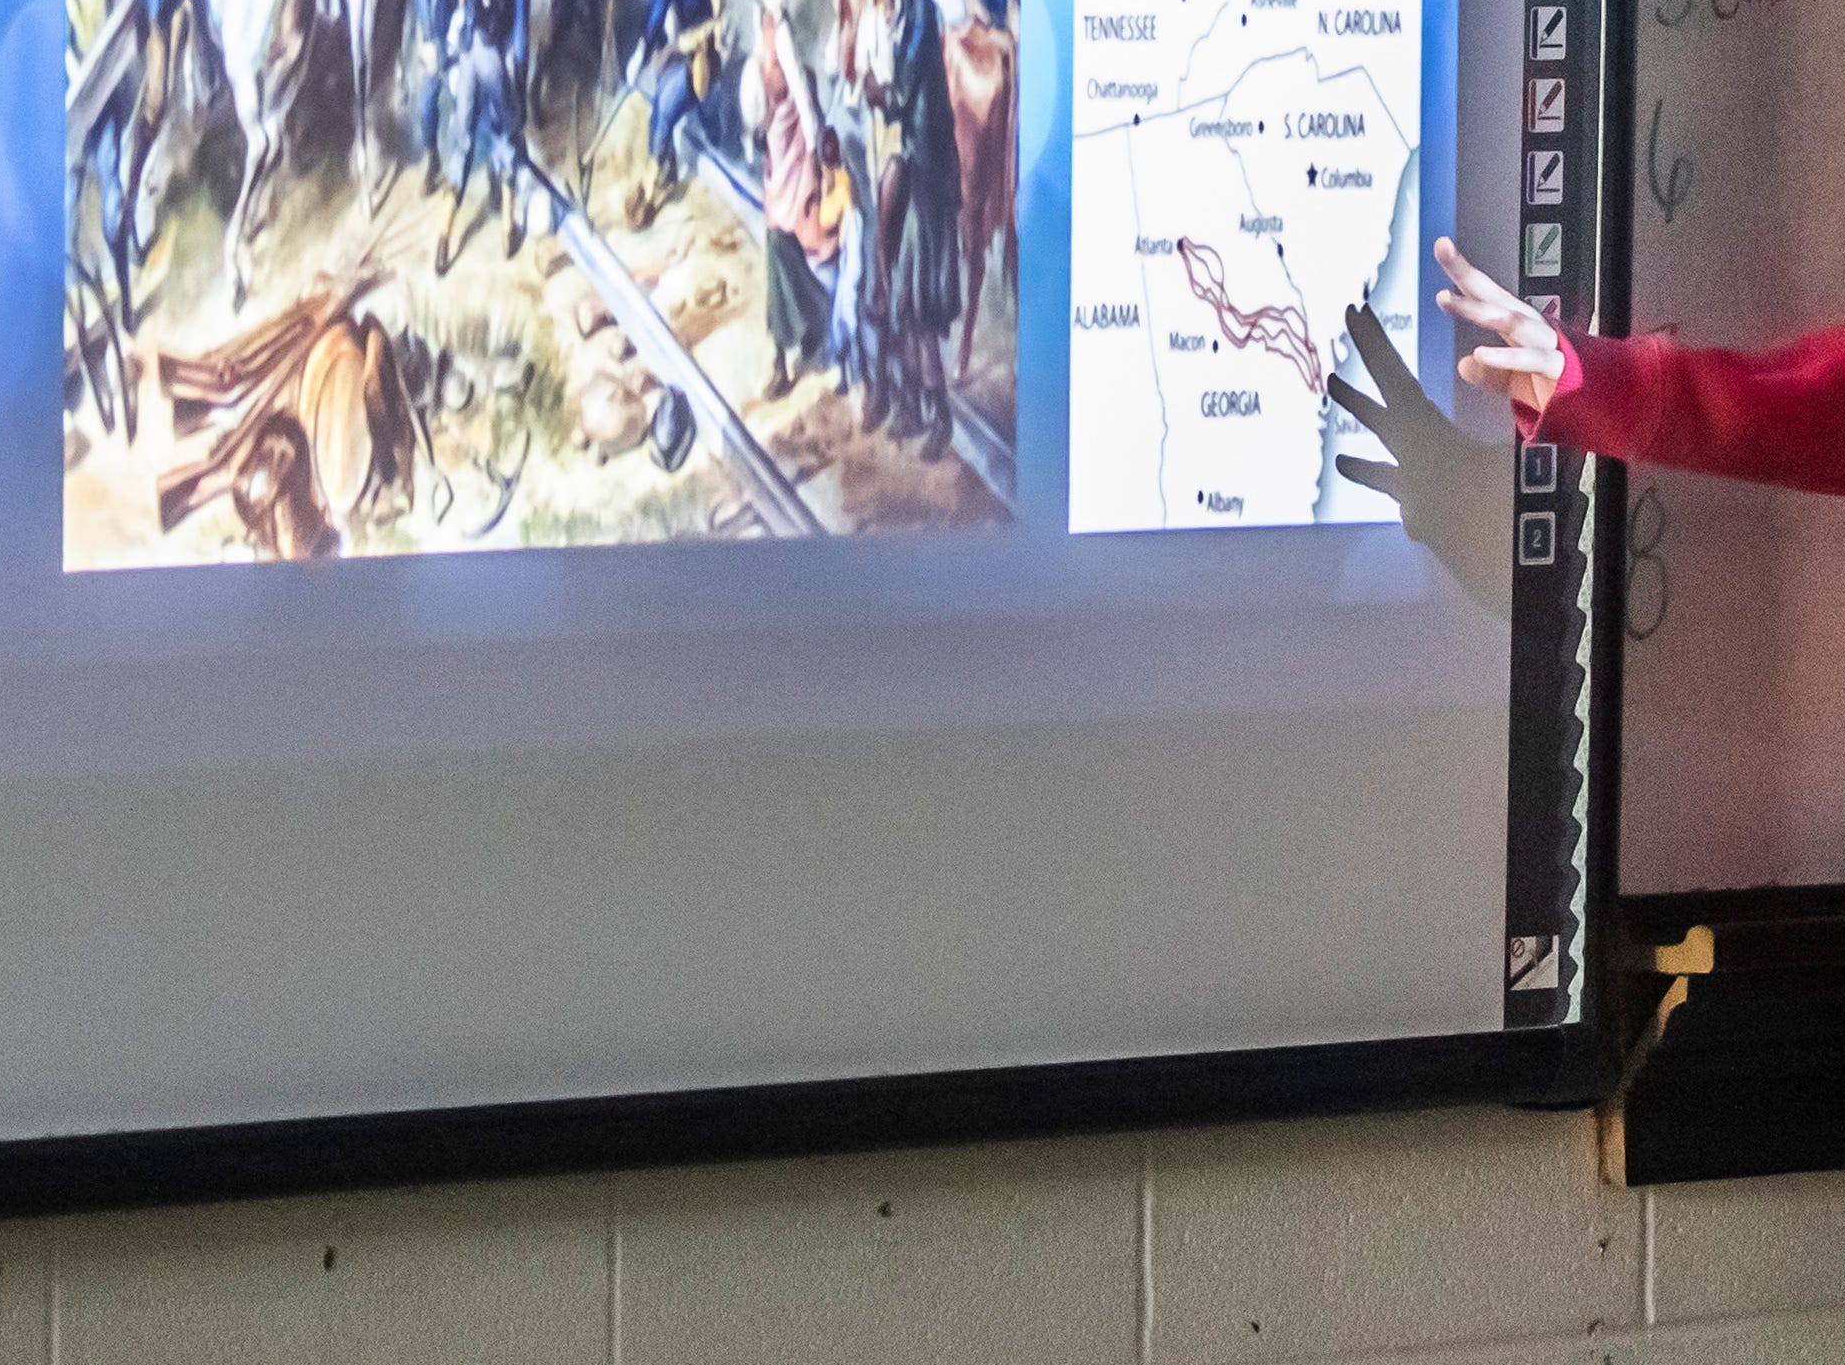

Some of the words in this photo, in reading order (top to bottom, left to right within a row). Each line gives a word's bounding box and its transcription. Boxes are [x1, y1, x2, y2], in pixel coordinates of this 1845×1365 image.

[1084, 15, 1157, 41] TENNESSEE
[1335, 9, 1402, 35] CAROLINA
[1087, 79, 1158, 104] Chattanooga
[1298, 112, 1366, 139] CAROLINA
[1321, 167, 1372, 189] Columbia
[1239, 214, 1284, 237] Augusta
[1135, 234, 1174, 256] Atlanta
[1073, 304, 1141, 330] ALABAMA
[1170, 331, 1205, 352] Macon
[1201, 390, 1262, 419] GEORGIA
[1207, 493, 1244, 517] Albany
